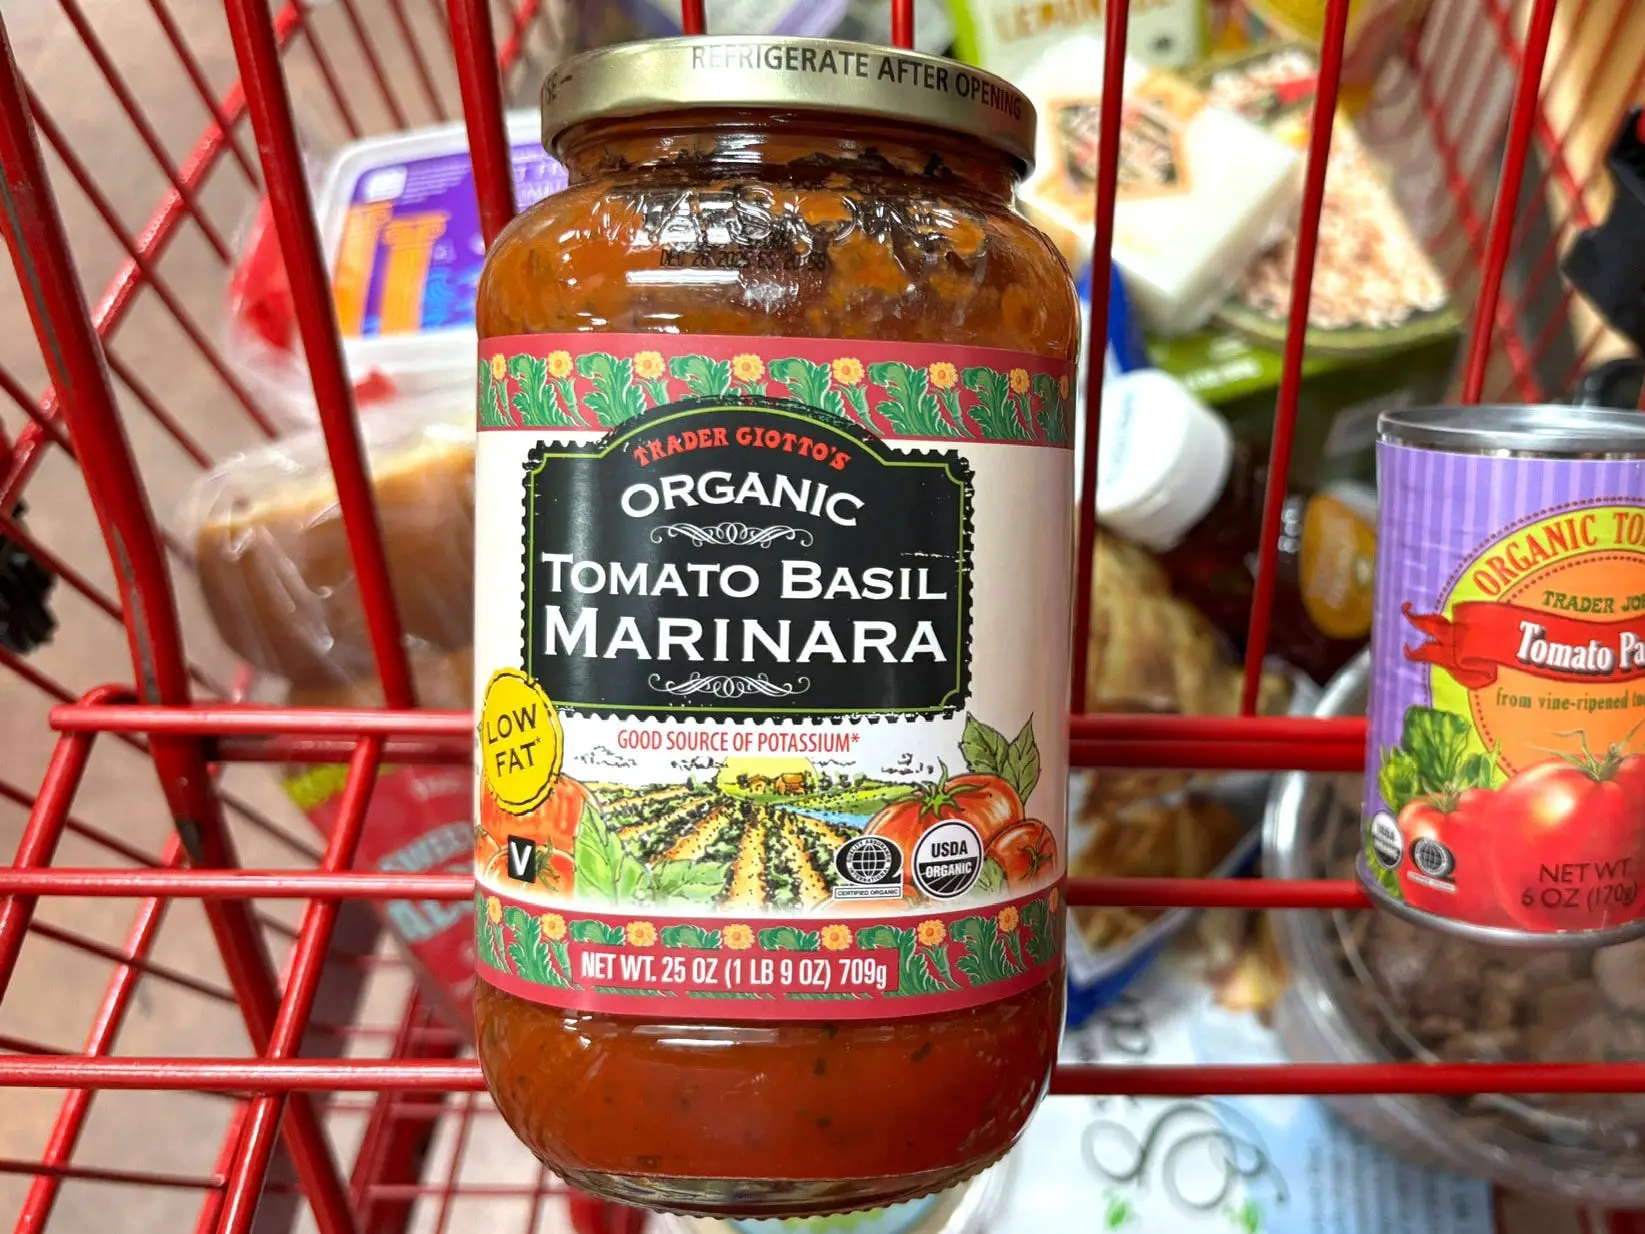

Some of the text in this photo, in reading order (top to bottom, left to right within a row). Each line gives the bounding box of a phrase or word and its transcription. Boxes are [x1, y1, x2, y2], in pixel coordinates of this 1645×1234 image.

[692, 45, 1022, 121] REFRIGERATE AFTER OPENING
[633, 426, 853, 471] TRADER GIOTTO'S
[620, 470, 866, 527] ORGANIC
[1472, 511, 1645, 597] ORGANIC TO
[541, 552, 948, 601] TOMATO BASIL
[1541, 589, 1615, 613] TRADER
[544, 604, 947, 664] MARINARA
[1516, 620, 1615, 673] Tomato
[1496, 687, 1533, 710] from
[1538, 690, 1629, 714] vine-ripened
[486, 703, 537, 745] LOW
[617, 729, 663, 750] GOOD
[666, 730, 729, 752] SOURCE
[733, 732, 753, 752] OF
[510, 841, 533, 876] V
[931, 840, 969, 858] USDA
[925, 861, 973, 879] ORGANIC
[1539, 858, 1632, 884] NET WT
[1521, 882, 1639, 912] 6 OZ (170g)
[581, 951, 887, 991] NET WT. 25 OZ (1 LB 9 OZ) 709g
